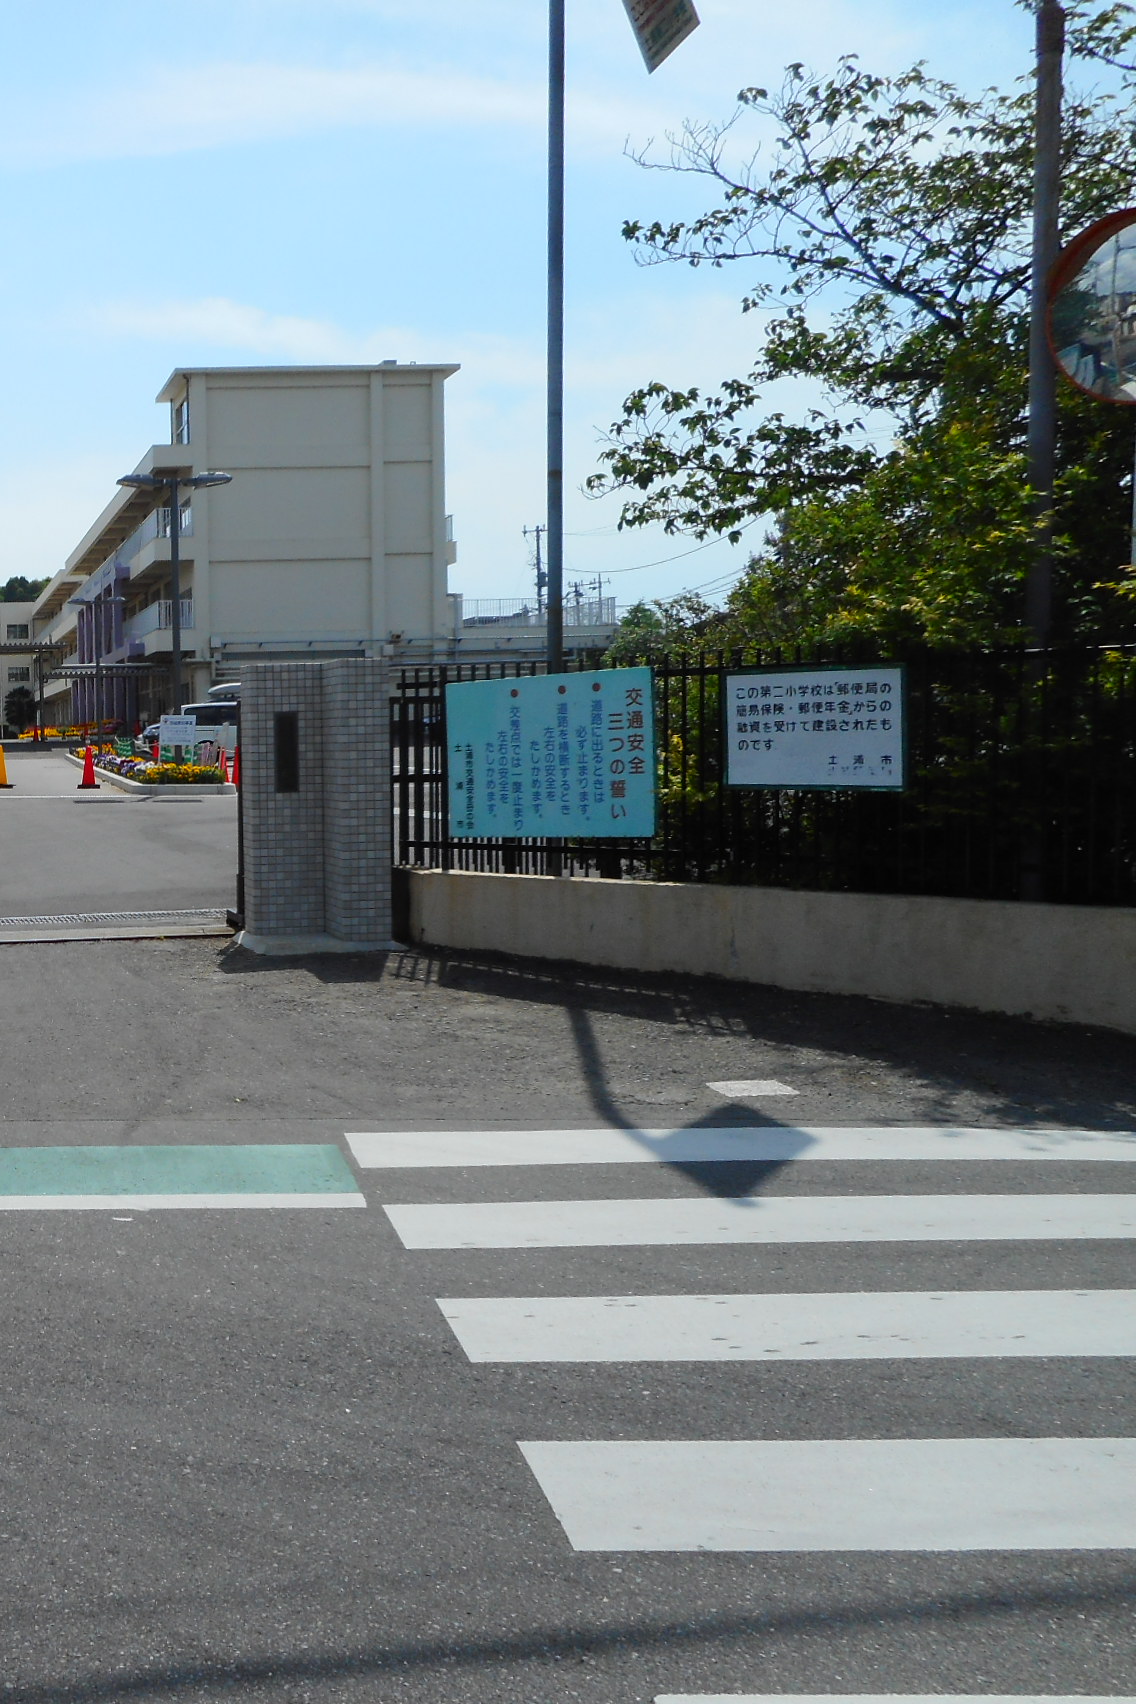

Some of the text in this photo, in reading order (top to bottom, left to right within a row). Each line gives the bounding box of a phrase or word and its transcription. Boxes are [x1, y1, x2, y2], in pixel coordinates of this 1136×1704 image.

[496, 730, 509, 804] 左右の安全を
[508, 706, 524, 831] 交差点では一度止まり
[543, 726, 557, 802] 左右の安全を
[556, 702, 570, 815] 道路を横断するとき
[590, 700, 604, 803] 道路に出るときは
[608, 713, 627, 820] 三つの誓い
[625, 688, 645, 775] 交通安全
[736, 717, 892, 734] 融資を受けて建設されたも
[485, 742, 497, 818] たしかめます。
[530, 740, 543, 818] たしかめます。
[575, 726, 590, 821] 必ず止まります。
